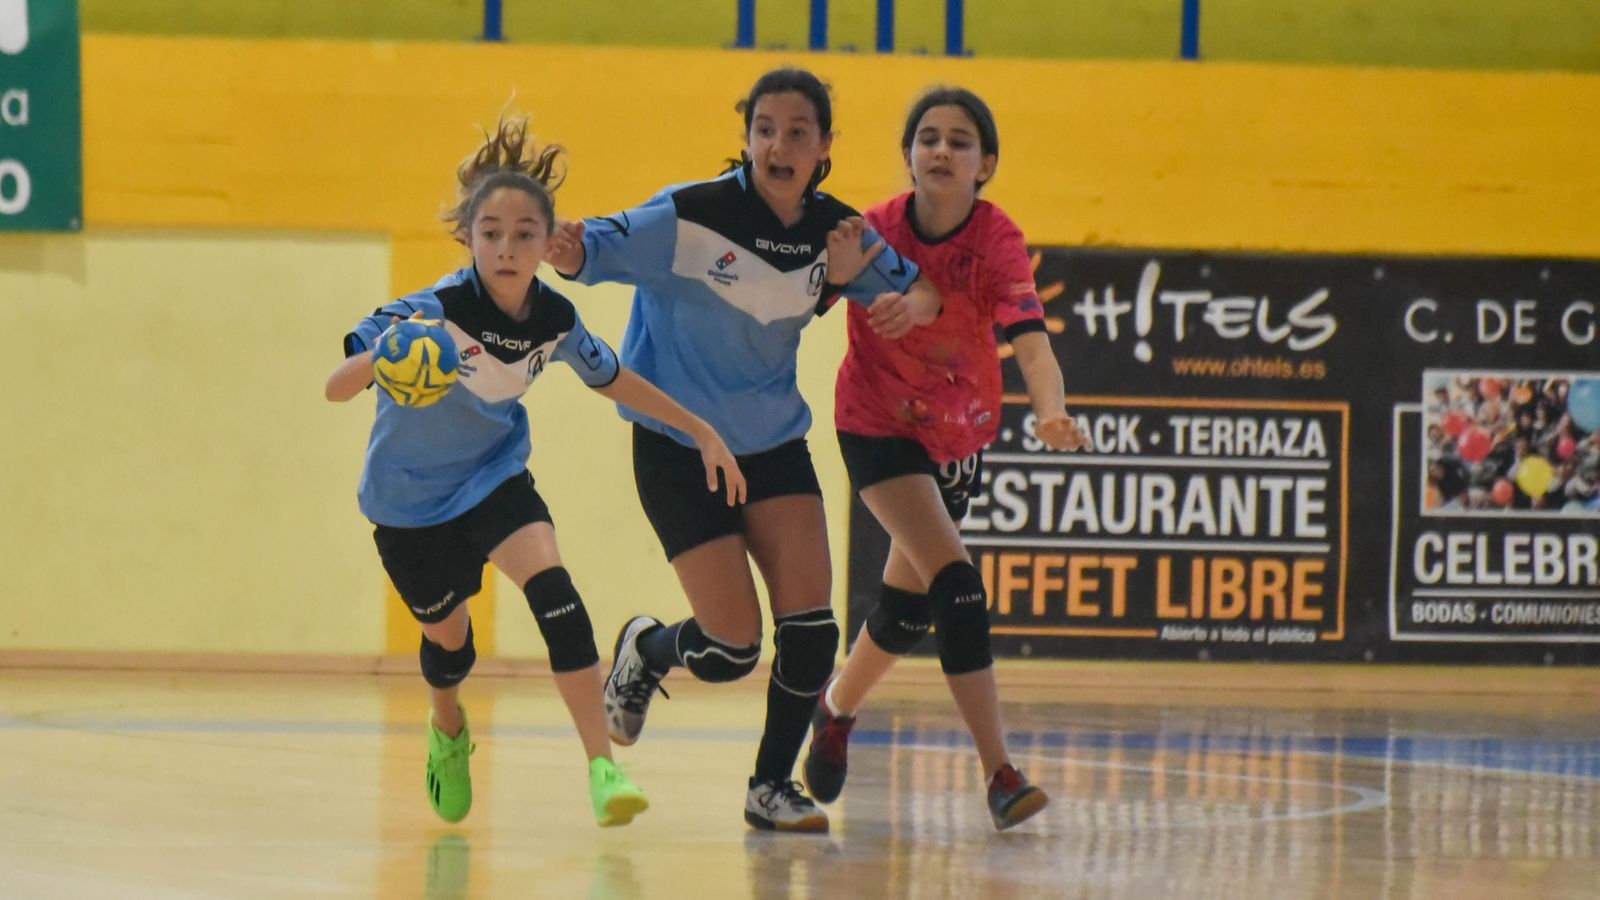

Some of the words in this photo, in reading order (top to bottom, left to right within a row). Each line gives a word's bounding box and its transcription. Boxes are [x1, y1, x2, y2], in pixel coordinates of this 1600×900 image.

[755, 238, 812, 255] GIVOVA
[1404, 298, 1454, 344] C.
[1476, 299, 1538, 345] DE
[1172, 356, 1327, 380] www.ohtels.es
[1021, 412, 1142, 455] SACK
[1168, 416, 1327, 458] TERRAZA
[939, 452, 978, 489] 99
[1413, 531, 1600, 586] CELEBR
[1156, 556, 1326, 622] LIBRE
[1411, 601, 1477, 624] BODAS
